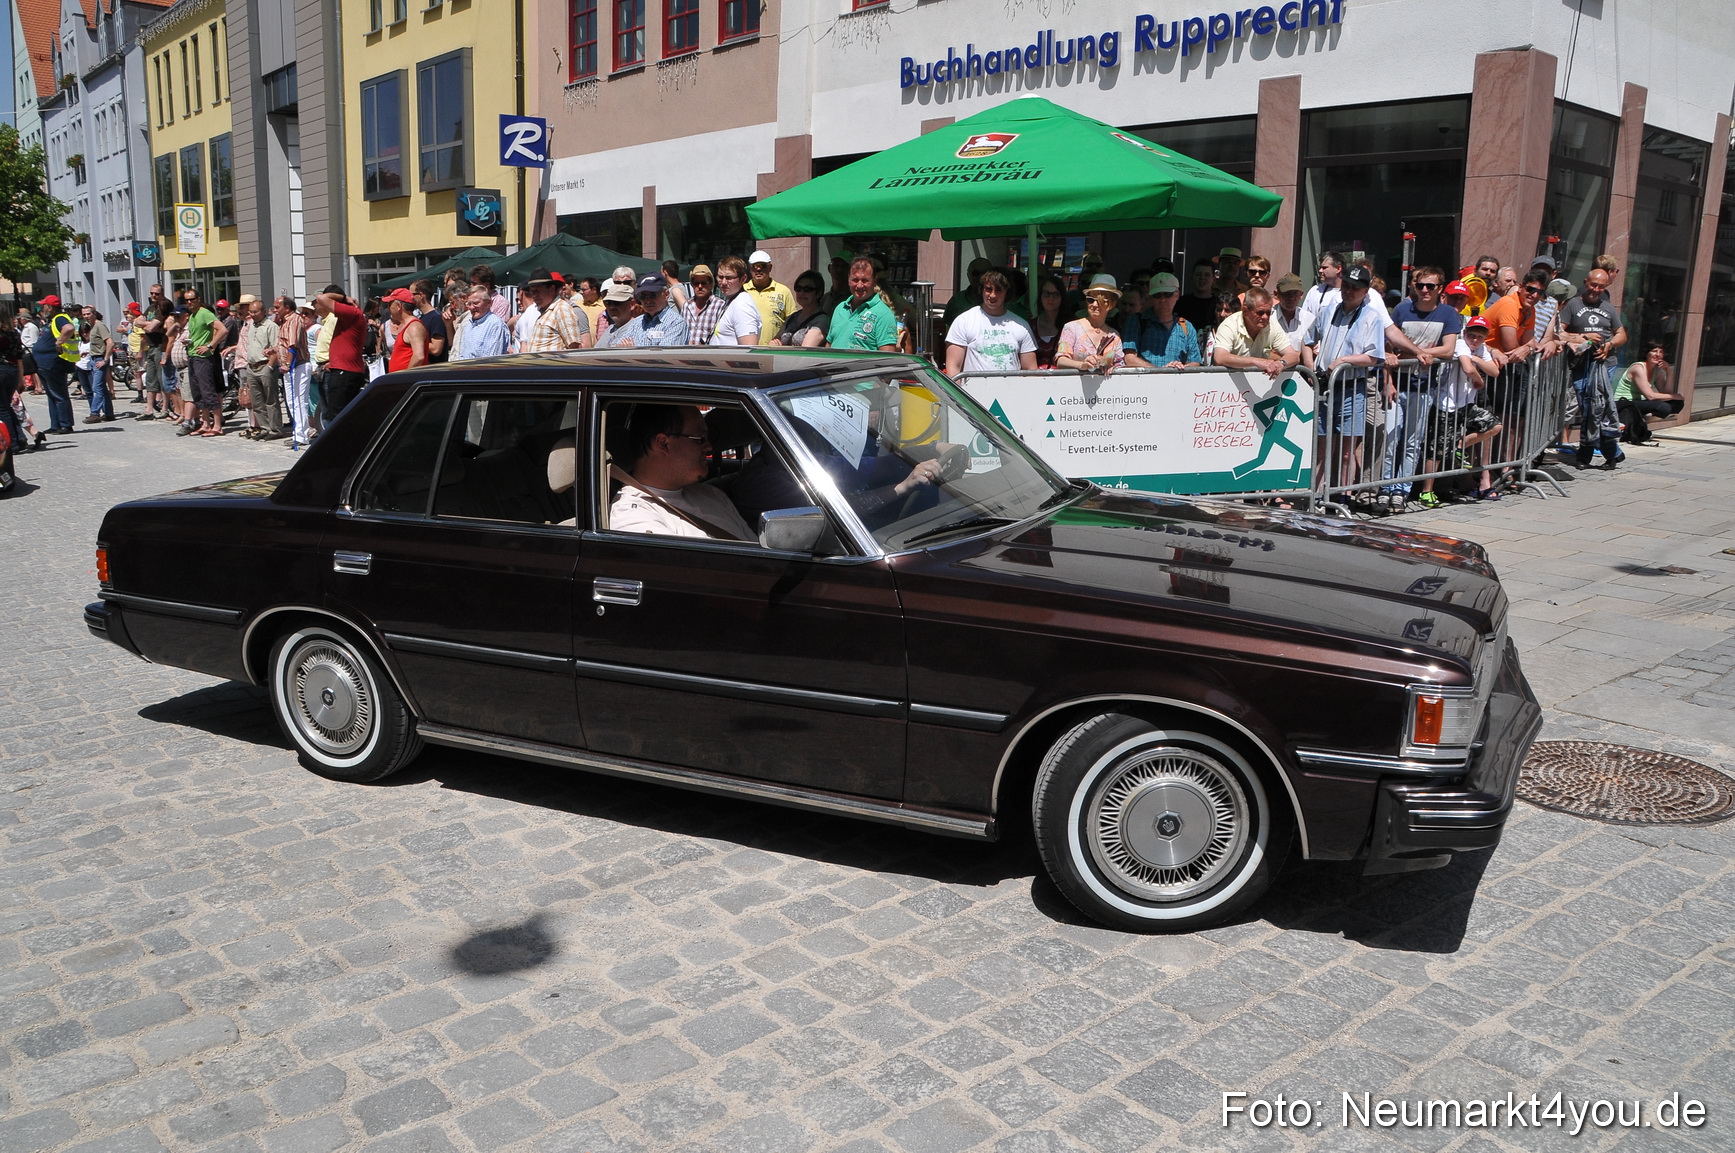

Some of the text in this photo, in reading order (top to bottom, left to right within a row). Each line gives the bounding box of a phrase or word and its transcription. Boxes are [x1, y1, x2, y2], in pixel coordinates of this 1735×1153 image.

[900, 0, 1345, 88] Buchhandlung Rupprecht
[903, 160, 1031, 175] Neumarkter
[551, 179, 585, 192] Unterer Markt 15
[868, 168, 1043, 190] Lammsbräu
[186, 212, 195, 224] H
[475, 202, 490, 220] G2
[1059, 395, 1148, 407] Gebäudereinigung
[1220, 390, 1251, 404] UNS
[828, 395, 854, 419] 598
[1059, 411, 1151, 422] Hausmeisterdienste
[1059, 428, 1113, 438] Mietservice
[1068, 443, 1158, 455] Event-Leit-Systeme
[1192, 435, 1254, 449] BESSER.
